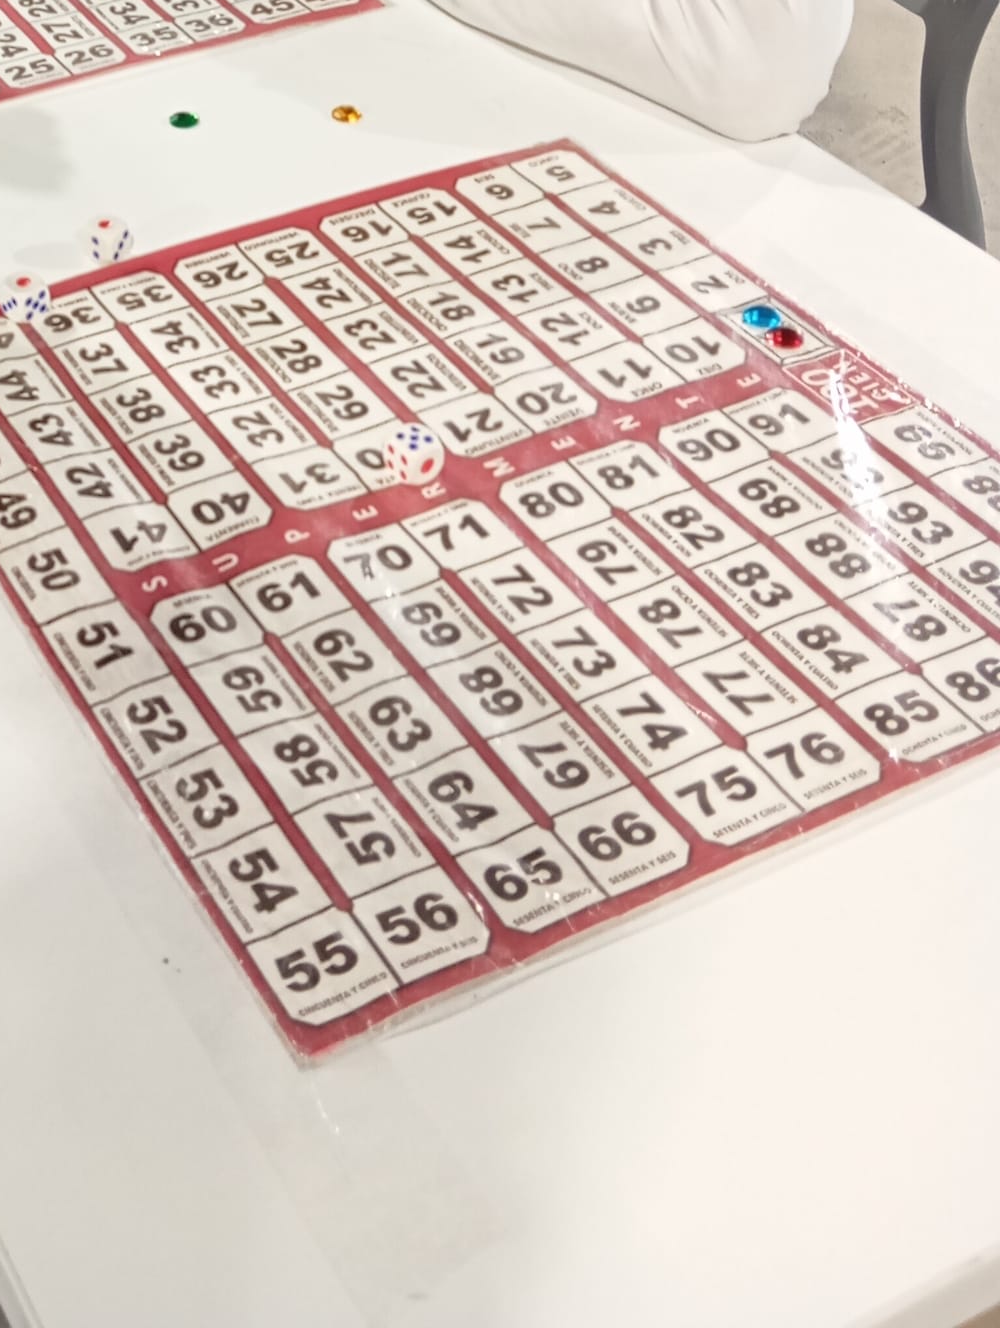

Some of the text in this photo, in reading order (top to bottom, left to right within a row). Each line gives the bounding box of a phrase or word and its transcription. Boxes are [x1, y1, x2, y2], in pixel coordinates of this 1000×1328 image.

[132, 25, 178, 47] 35
[185, 16, 234, 32] 36
[6, 59, 54, 80] 25
[64, 44, 113, 65] 26
[546, 164, 576, 183] 5
[486, 184, 514, 200] 6
[588, 199, 620, 217] 4
[408, 202, 456, 224] 15
[529, 216, 561, 235] 7
[342, 222, 392, 242] 16
[445, 236, 490, 262] 14
[640, 239, 672, 254] 3
[266, 242, 319, 268] 25
[382, 253, 428, 282] 17
[576, 258, 608, 273] 8
[194, 262, 248, 288] 26
[492, 275, 538, 302] 13
[692, 275, 729, 293] 2
[118, 286, 172, 310] 35
[302, 278, 352, 308] 24
[429, 292, 474, 320] 18
[627, 296, 660, 313] 9
[44, 307, 100, 332] 36
[232, 300, 282, 330] 27
[541, 312, 589, 348] 12
[152, 322, 199, 354] 34
[344, 320, 396, 350] 23
[477, 333, 525, 366] 19
[667, 338, 720, 362] 10
[80, 344, 128, 374] 37
[271, 340, 322, 374] 28
[598, 360, 651, 386] 11
[191, 366, 240, 398] 33
[392, 360, 445, 398] 22
[116, 388, 165, 423] 38
[316, 386, 368, 420] 29
[516, 379, 577, 415] 20
[28, 414, 72, 446] 43
[233, 412, 283, 446] 32
[444, 408, 502, 442] 21
[748, 405, 810, 436] 91
[154, 434, 204, 472] 39
[678, 429, 740, 460] 90
[66, 464, 112, 498] 42
[280, 464, 338, 492] 31
[598, 456, 658, 490] 81
[192, 492, 250, 524] 40
[519, 482, 584, 518] 80
[739, 478, 800, 518] 89
[110, 522, 166, 553] 41
[424, 515, 488, 550] 71
[662, 506, 724, 550] 82
[888, 501, 954, 545] 93
[28, 548, 80, 590] 50
[578, 541, 636, 585] 79
[806, 534, 870, 578] 88
[257, 572, 320, 612] 61
[492, 565, 552, 614] 72
[728, 562, 792, 607] 83
[169, 606, 236, 642] 60
[402, 602, 461, 646] 69
[638, 599, 702, 648] 78
[77, 622, 134, 669] 51
[314, 630, 373, 682] 62
[552, 626, 616, 676] 73
[798, 626, 868, 673] 84
[222, 666, 282, 712] 59
[460, 666, 523, 716] 68
[704, 672, 774, 715] 77
[945, 658, 1000, 702] 86
[127, 696, 187, 754] 52
[370, 696, 432, 752] 63
[618, 692, 686, 750] 74
[864, 691, 938, 736] 85
[274, 734, 338, 786] 58
[519, 742, 589, 788] 67
[764, 733, 844, 778] 76
[176, 768, 238, 829] 53
[428, 771, 498, 830] 64
[676, 766, 756, 816] 75
[324, 812, 395, 866] 57
[578, 812, 656, 860] 66
[229, 848, 298, 912] 54
[484, 848, 562, 902] 65
[376, 894, 458, 944] 56
[276, 932, 358, 992] 55
